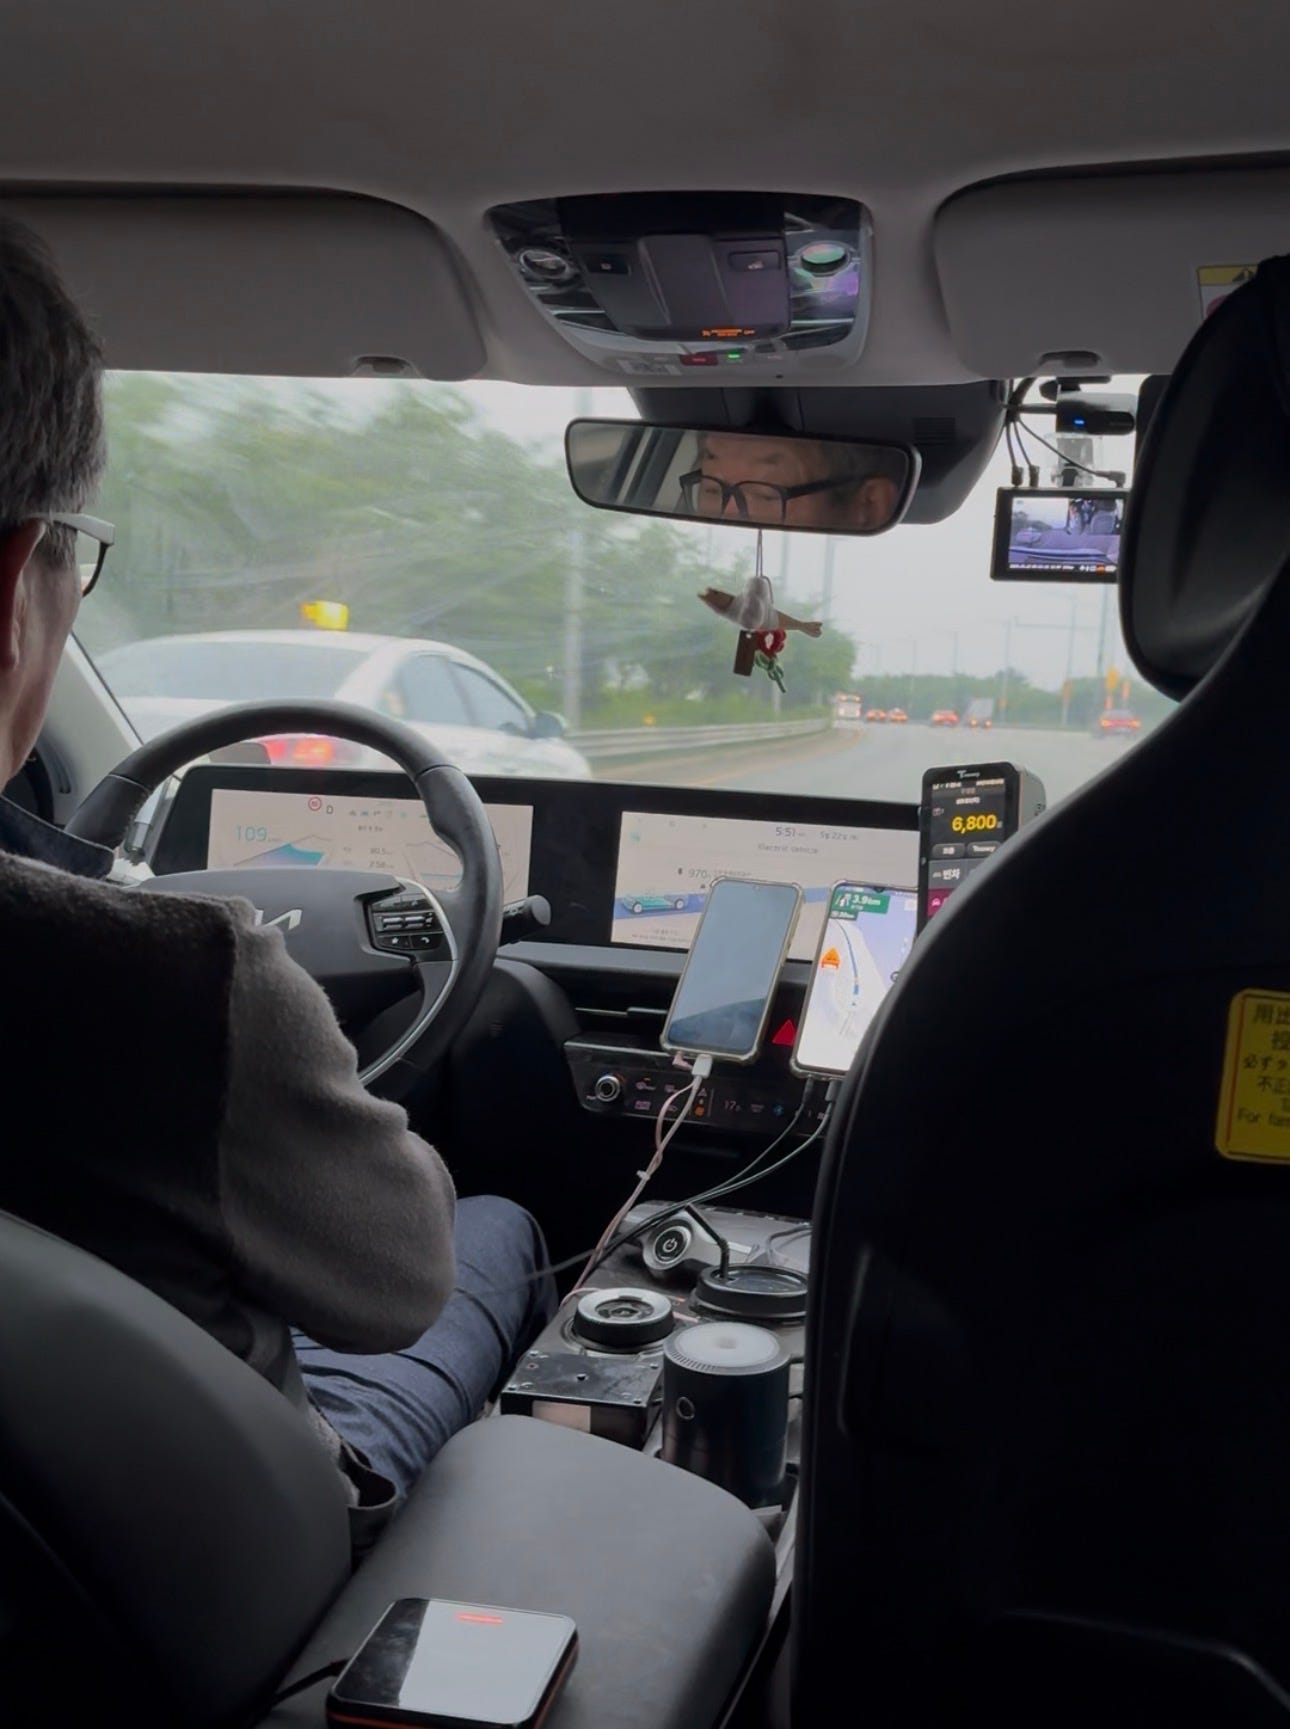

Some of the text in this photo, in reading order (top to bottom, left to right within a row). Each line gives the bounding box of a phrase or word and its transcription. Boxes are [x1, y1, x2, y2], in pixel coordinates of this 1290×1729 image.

[775, 826, 797, 837] 5:51
[952, 814, 997, 834] 6,800
[237, 826, 267, 841] 109
[1238, 1107, 1262, 1123] For
